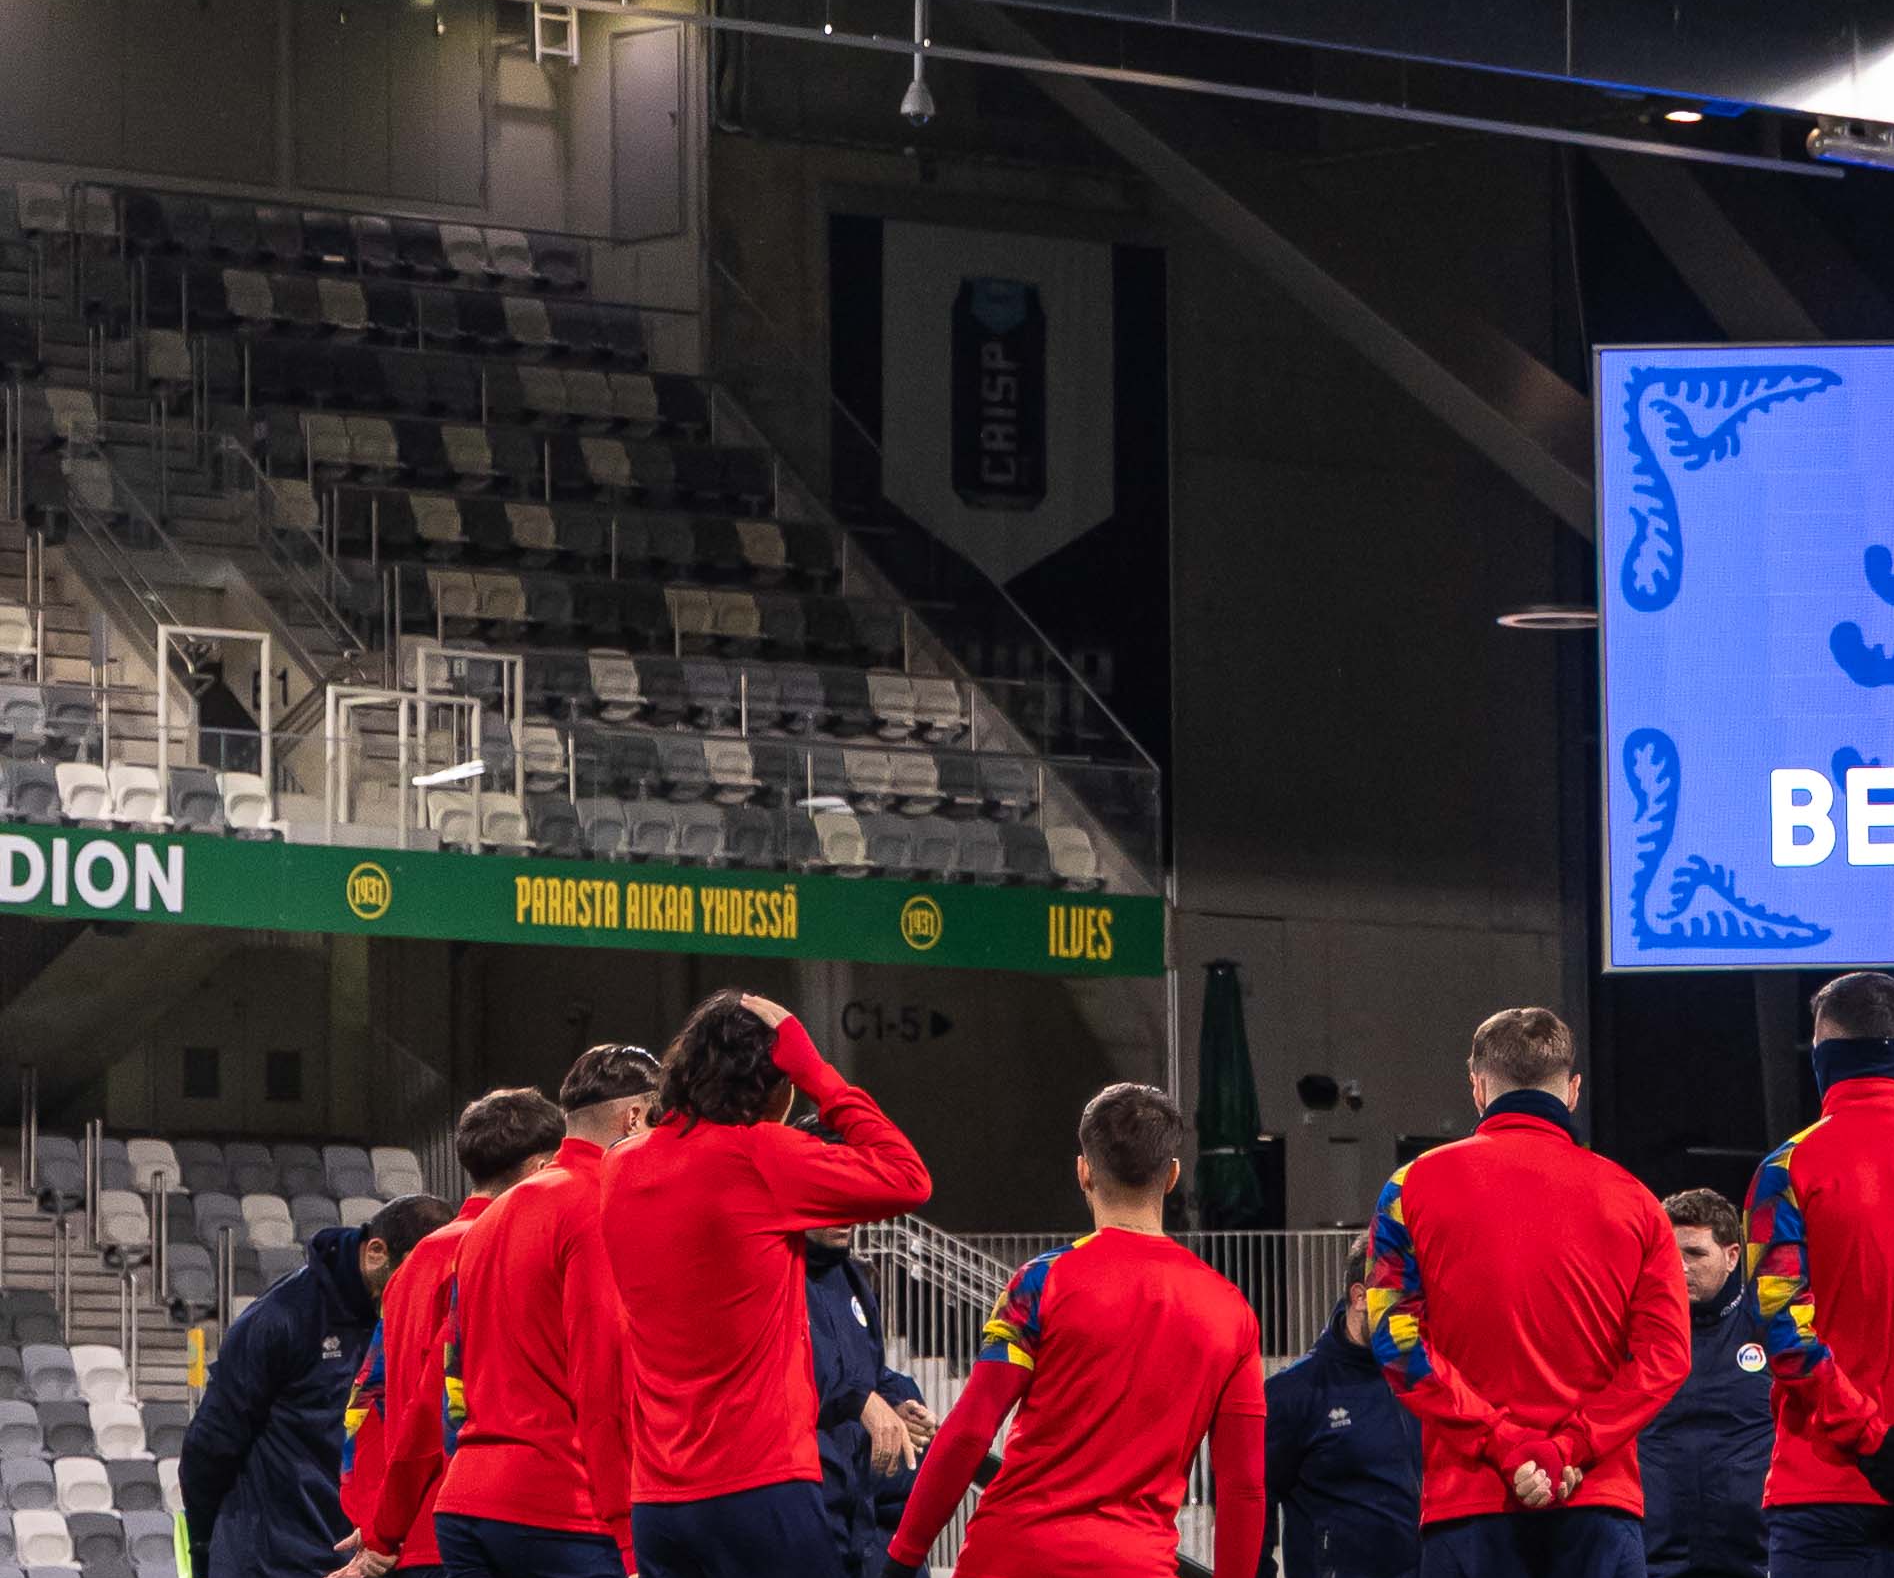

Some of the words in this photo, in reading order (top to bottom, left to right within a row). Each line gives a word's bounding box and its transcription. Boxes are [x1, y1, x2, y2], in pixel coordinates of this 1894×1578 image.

[0, 834, 184, 913] DION
[515, 876, 619, 929] PARASTA
[626, 881, 695, 933] AIKAA
[701, 884, 798, 940] YHDESSÄ
[842, 1002, 921, 1043] C1-5
